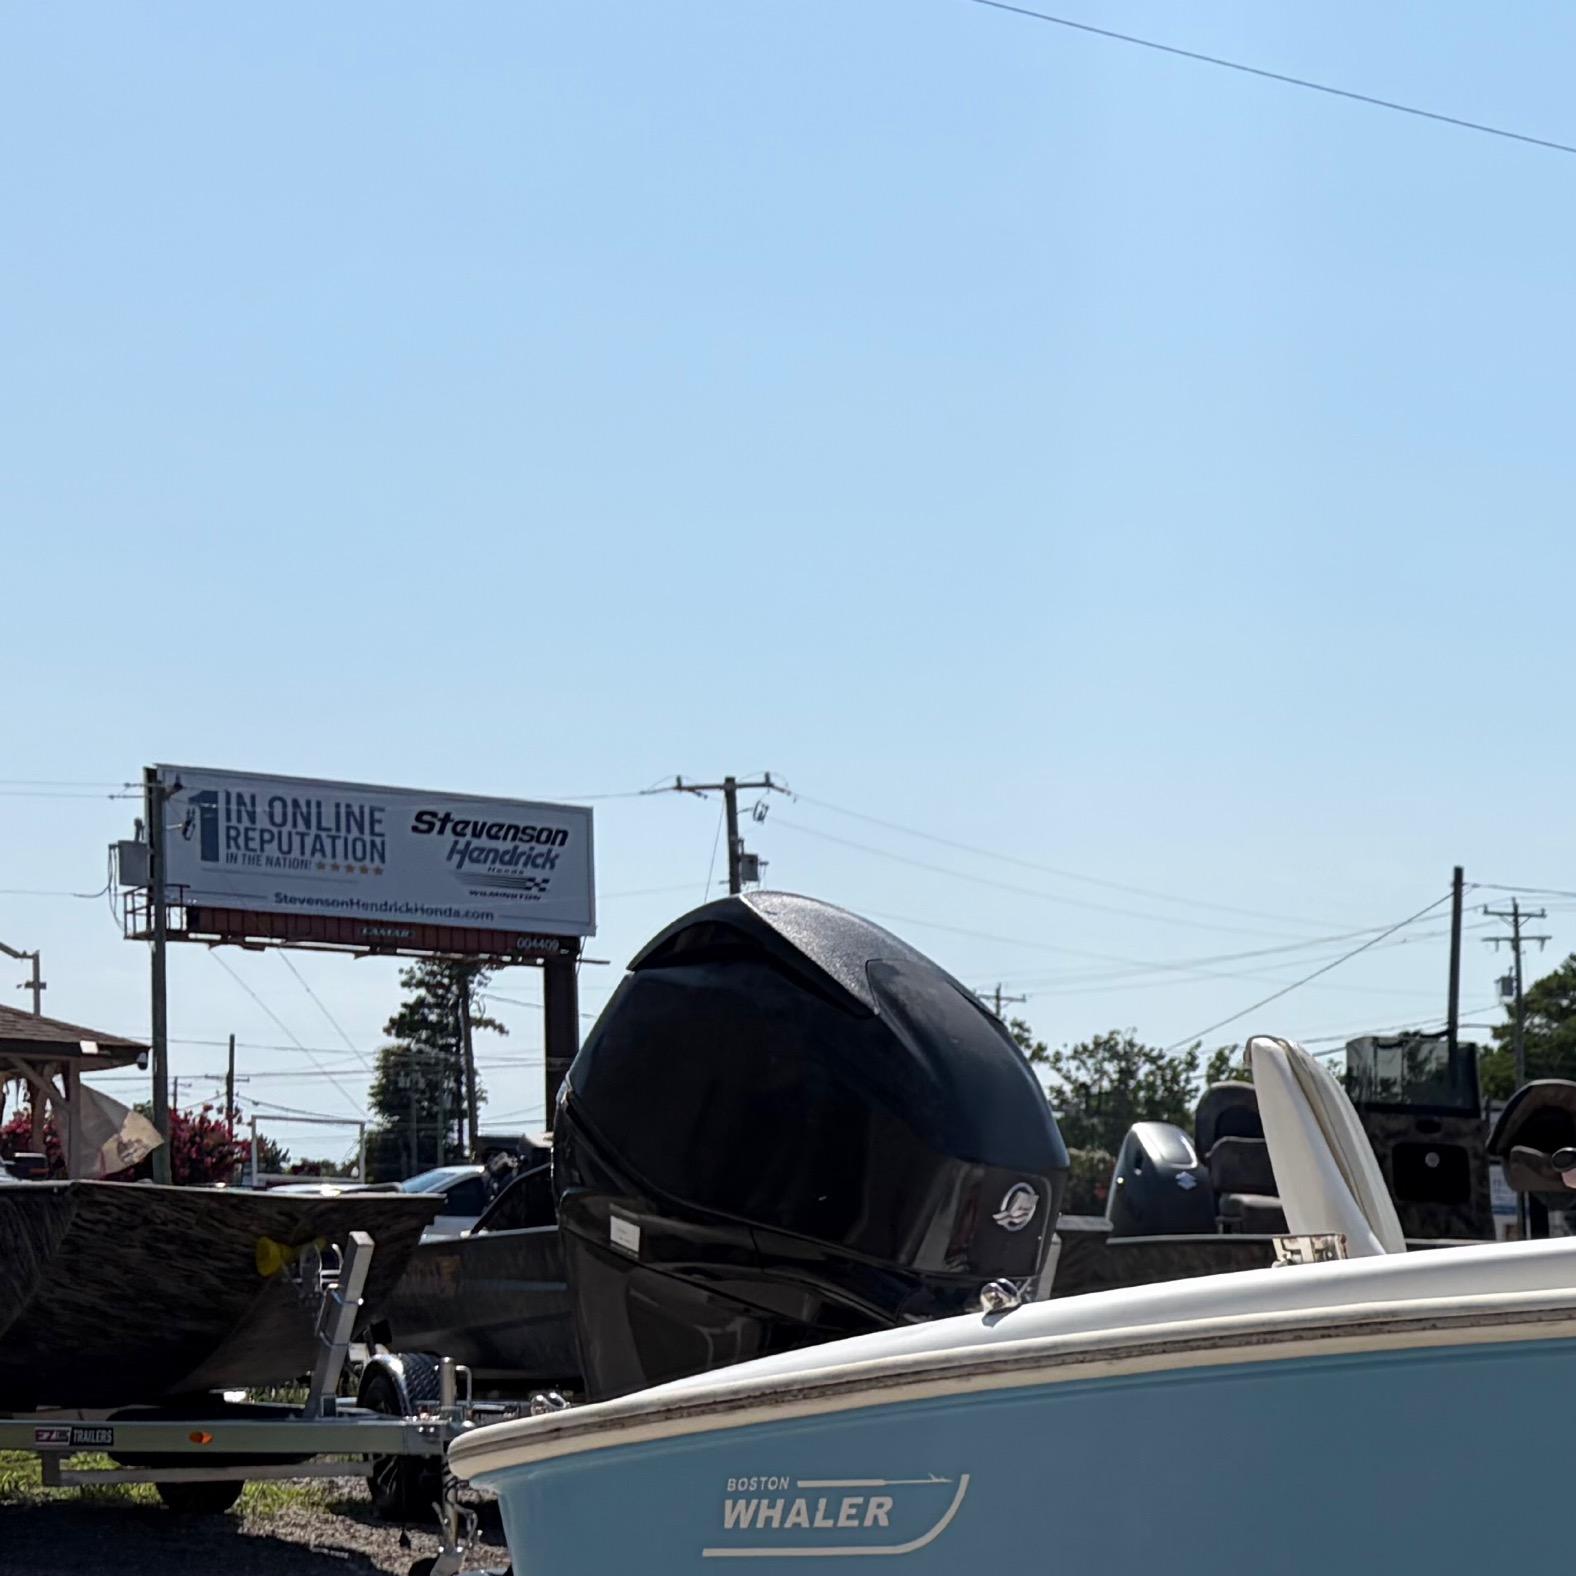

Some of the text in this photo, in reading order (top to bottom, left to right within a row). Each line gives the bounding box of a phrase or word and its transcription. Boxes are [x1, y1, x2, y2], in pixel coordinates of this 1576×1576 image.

[224, 789, 387, 838] IN ONLINE
[411, 810, 569, 847] Stevenson
[225, 825, 387, 865] REPUTATION
[225, 852, 239, 865] IN
[241, 853, 263, 868] THE
[446, 840, 560, 871] Hendrick
[273, 892, 495, 921] StevensonHendrickHonda.com
[73, 1429, 113, 1444] TRAILERS
[727, 1476, 790, 1492] BOSTON
[723, 1496, 893, 1529] WHALER
